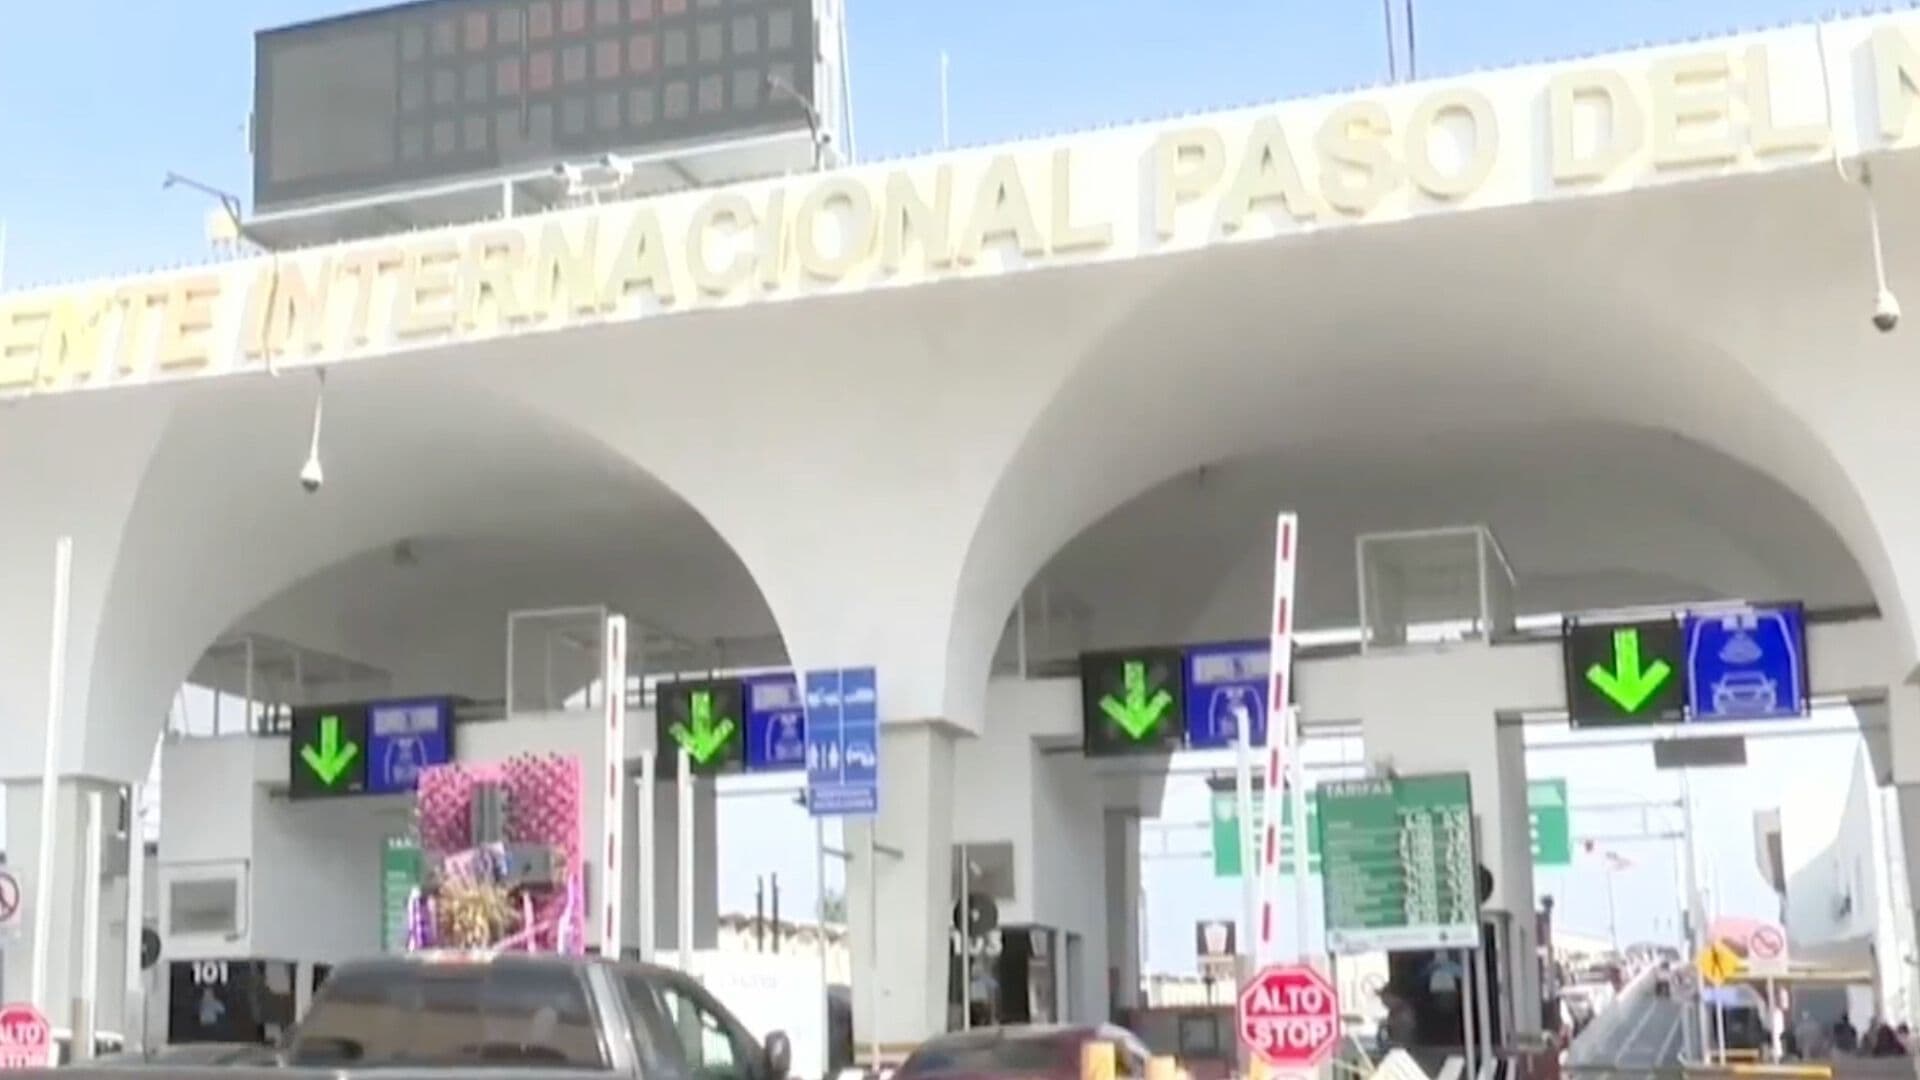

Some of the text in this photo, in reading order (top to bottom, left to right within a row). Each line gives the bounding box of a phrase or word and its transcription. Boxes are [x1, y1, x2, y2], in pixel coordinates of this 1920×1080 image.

[238, 148, 1113, 360] INTERNACIONAL
[1150, 86, 1500, 243] PASO
[1546, 44, 1831, 187] DEL
[192, 960, 229, 985] 101
[1251, 983, 1324, 1014] ALTO
[1254, 1022, 1328, 1050] STOP
